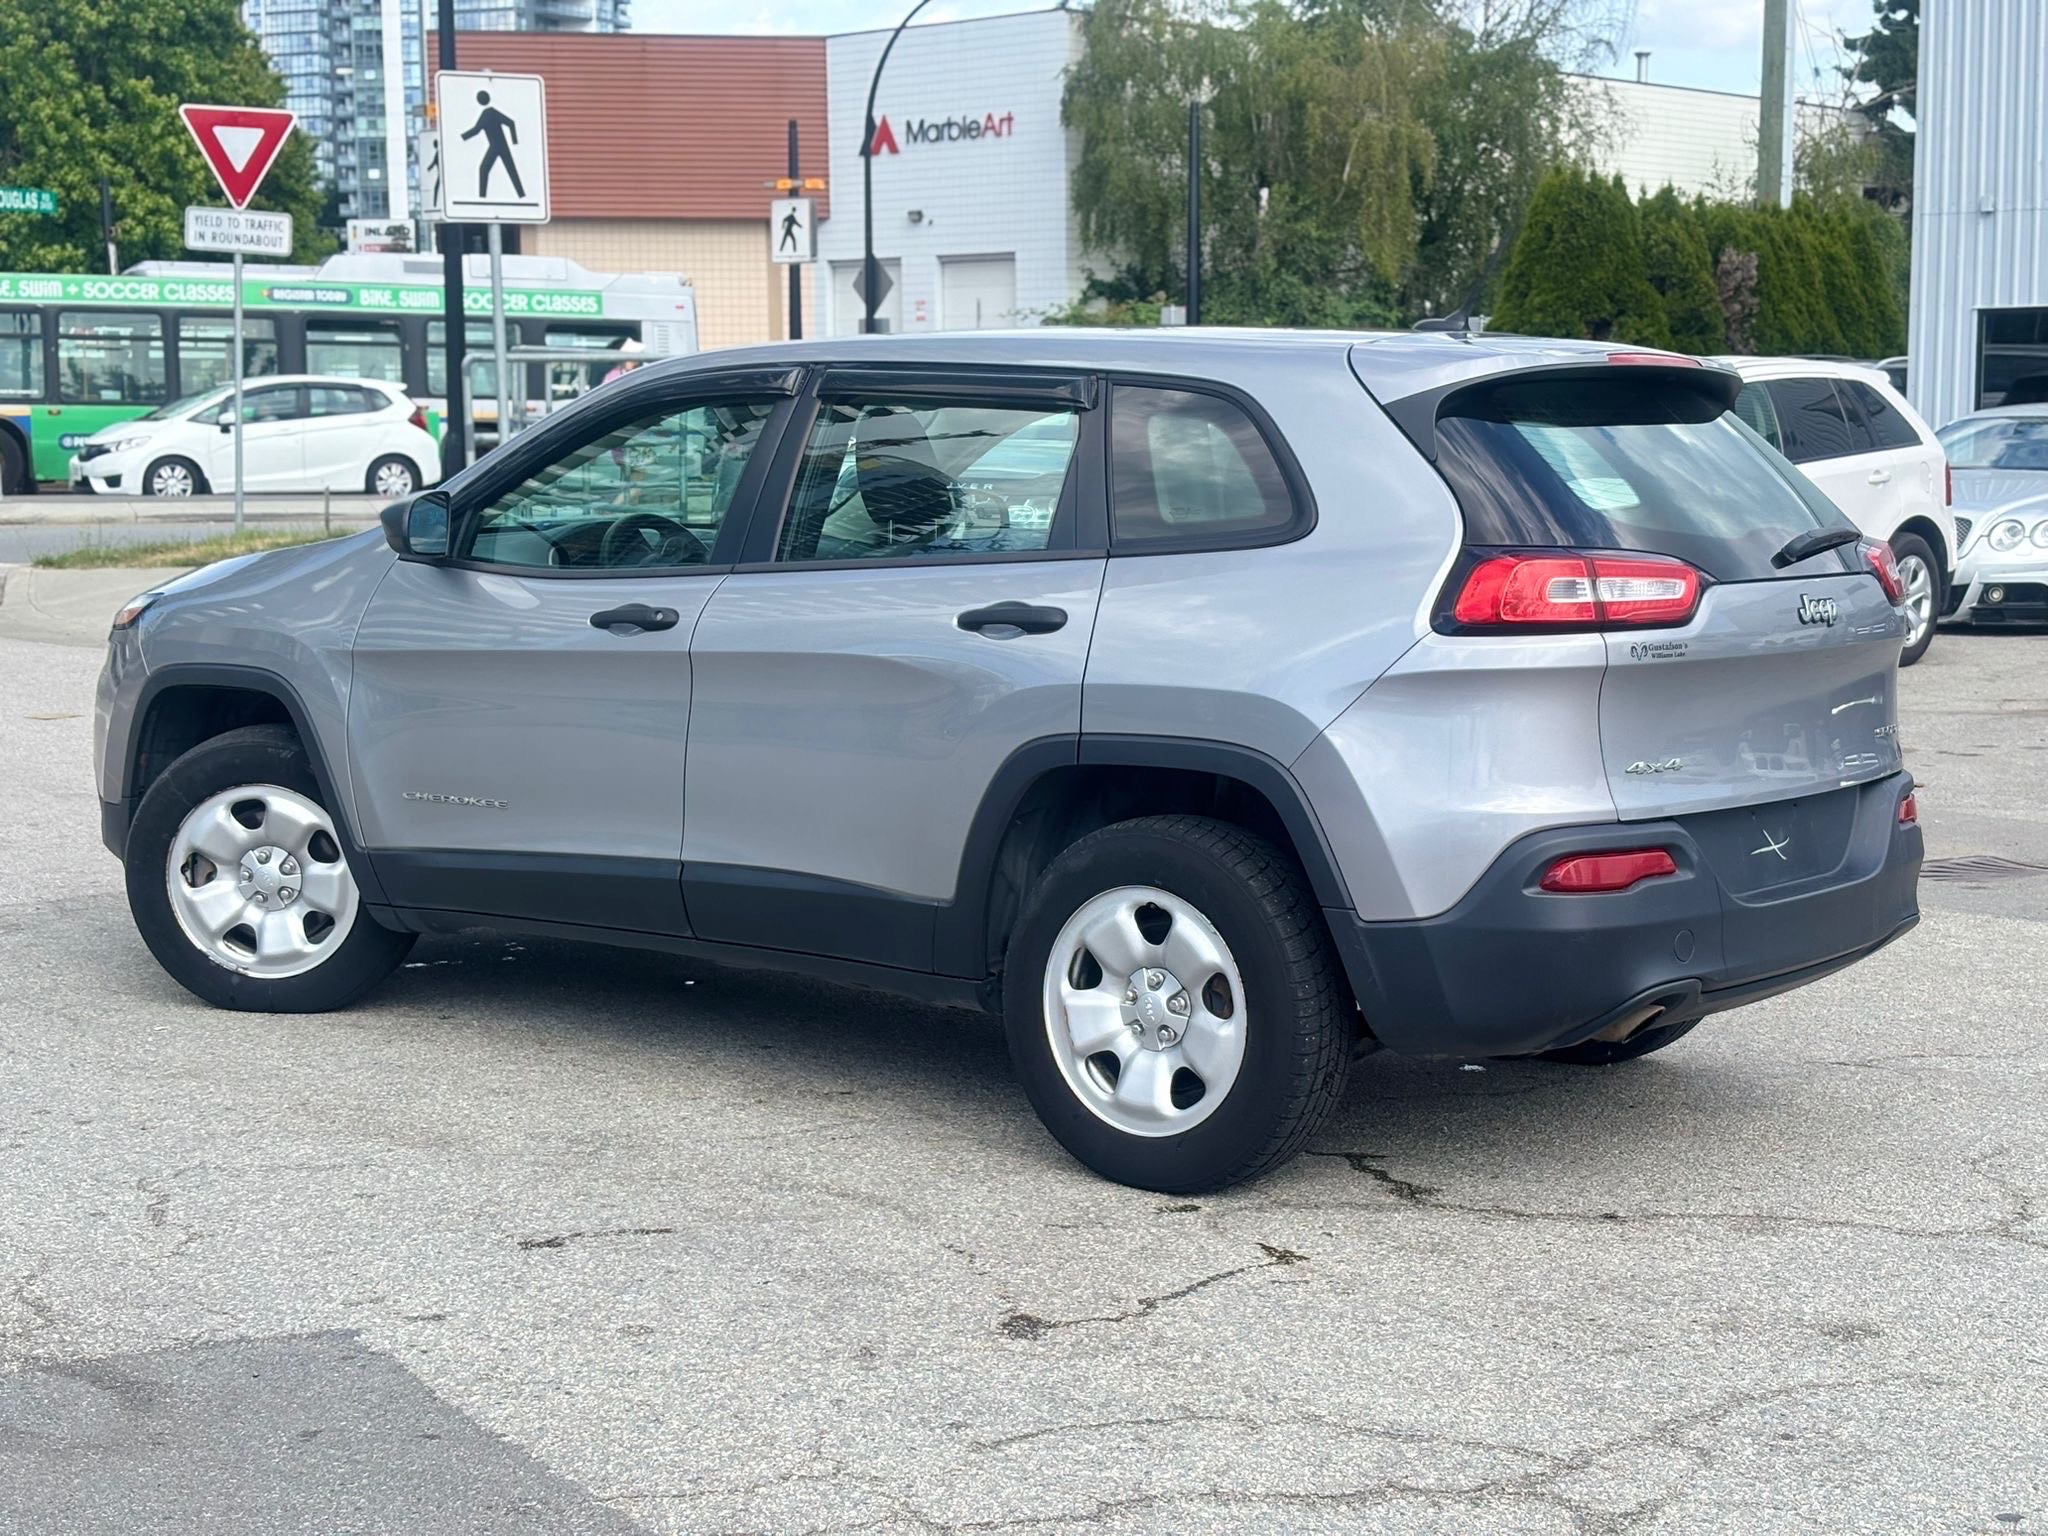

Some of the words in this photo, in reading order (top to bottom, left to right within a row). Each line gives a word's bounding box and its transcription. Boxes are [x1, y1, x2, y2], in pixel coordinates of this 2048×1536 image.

[906, 111, 1014, 144] MarbleArt
[195, 215, 222, 227] YIELD
[228, 216, 240, 229] TO
[244, 218, 283, 232] TRAFFIC
[194, 231, 205, 241] IN
[211, 232, 283, 248] ROUNDABOUT
[82, 281, 159, 300] SOCCER
[1798, 593, 1837, 628] Jeep
[1648, 641, 1688, 652] Gustafson's
[1625, 757, 1684, 775] 4x4
[402, 790, 508, 809] CHEROKEE
